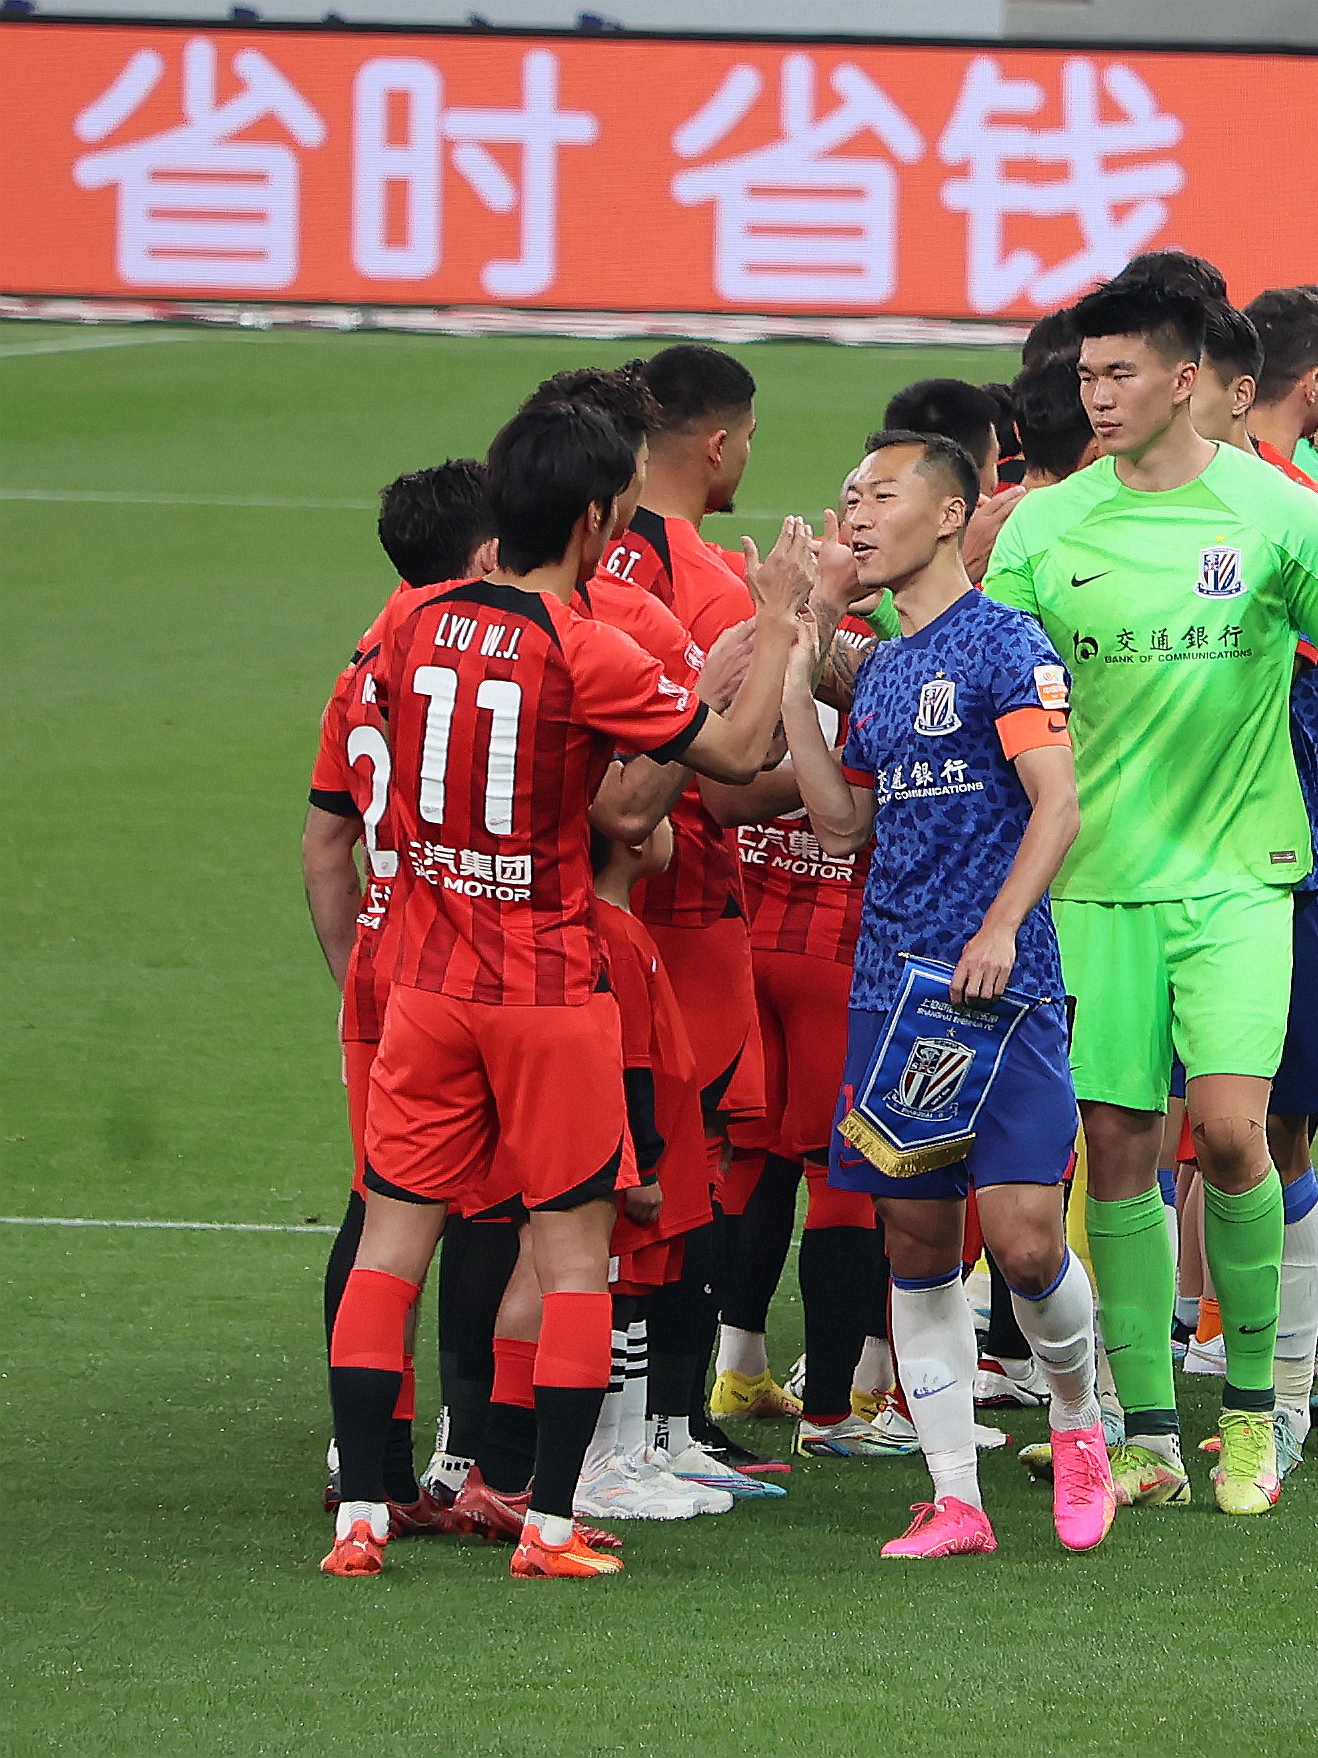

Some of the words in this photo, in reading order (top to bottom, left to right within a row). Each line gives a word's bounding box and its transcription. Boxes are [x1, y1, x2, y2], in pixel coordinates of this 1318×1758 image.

[73, 36, 599, 299] 省时
[670, 52, 1185, 315] 省钱
[434, 612, 478, 652] LYU
[480, 623, 521, 660] W.J.
[1115, 624, 1244, 653] 交通銀行
[1104, 655, 1135, 664] BANK
[1139, 655, 1153, 664] OF
[1158, 649, 1253, 662] COMMUNICATIONS
[412, 666, 522, 835] 11
[771, 856, 853, 882] MOTOR
[443, 876, 532, 902] MOTOR
[355, 913, 382, 930] SA
